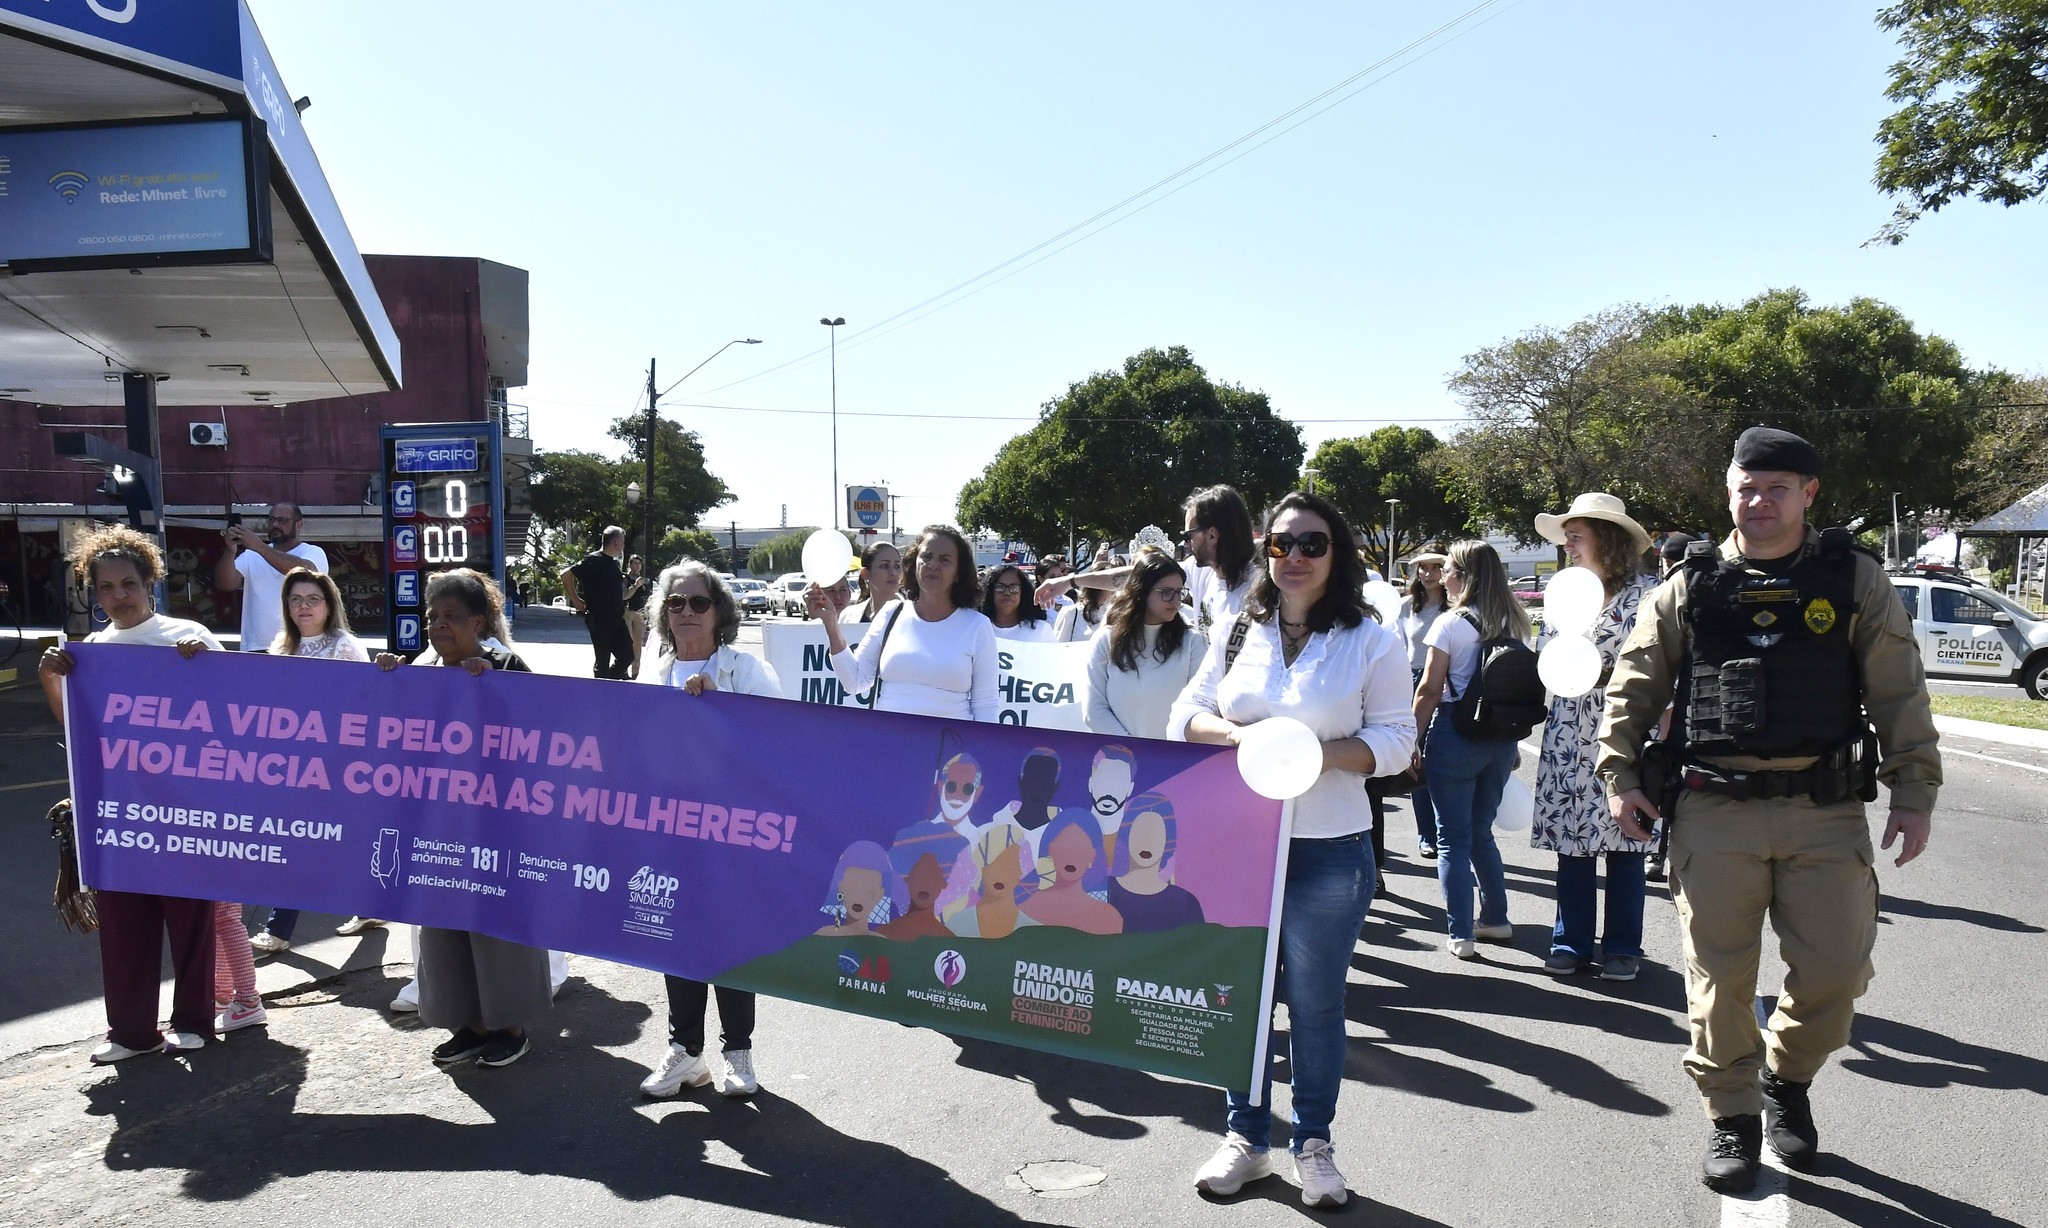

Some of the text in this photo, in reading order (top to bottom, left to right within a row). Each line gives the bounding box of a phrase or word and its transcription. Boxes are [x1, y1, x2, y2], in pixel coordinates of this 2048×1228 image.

[100, 191, 140, 203] Rede:
[428, 449, 475, 461] GRIFO
[395, 485, 413, 506] G
[854, 501, 884, 511] ILHA FM
[396, 529, 415, 551] G
[397, 574, 416, 596] E
[399, 619, 418, 639] D
[1938, 637, 2004, 652] POLÍCIA
[1937, 650, 2003, 661] CIENTÍFICA
[103, 693, 603, 772] PELA VIDA E PELO FIM DA
[99, 737, 798, 853] VIOLÊNCIA CONTRA AS MULHERES!
[97, 800, 343, 841] SE SOUBER DE ALGUM
[167, 835, 287, 864] DENUNCIE.
[413, 837, 466, 854] Denúncia
[411, 851, 463, 867] anônima:
[471, 846, 499, 873] 181
[519, 852, 567, 871] Denúncia
[518, 867, 548, 882] crime:
[572, 863, 610, 892] 190
[408, 874, 507, 897] policiacivil.pr.gov.br
[641, 873, 679, 898] APP
[629, 891, 675, 910] SINDICATO
[838, 976, 886, 995] PARANÁ
[1014, 960, 1094, 991] PARANÁ
[907, 989, 988, 1012] MULHER SEGURA
[928, 987, 967, 999] PROGRAMA
[1013, 978, 1094, 1005] UNIDO NO
[1116, 977, 1208, 1009] PARANÁ
[1015, 999, 1089, 1021] COMBATE AO
[1115, 998, 1164, 1011] GOVERNO
[1192, 1011, 1233, 1023] ESTADO
[1130, 1008, 1172, 1021] SECRETARIA
[1184, 1018, 1215, 1029] MULHER,
[1139, 1018, 1205, 1035] IGUALDADE RACIAL
[1149, 1027, 1175, 1037] PESSOA
[1176, 1032, 1199, 1041] IDOSA
[1135, 1039, 1205, 1057] SEGURANÇA PÚBLICA
[1148, 1034, 1188, 1047] SECRETARIA
[1189, 1041, 1199, 1049] DA
